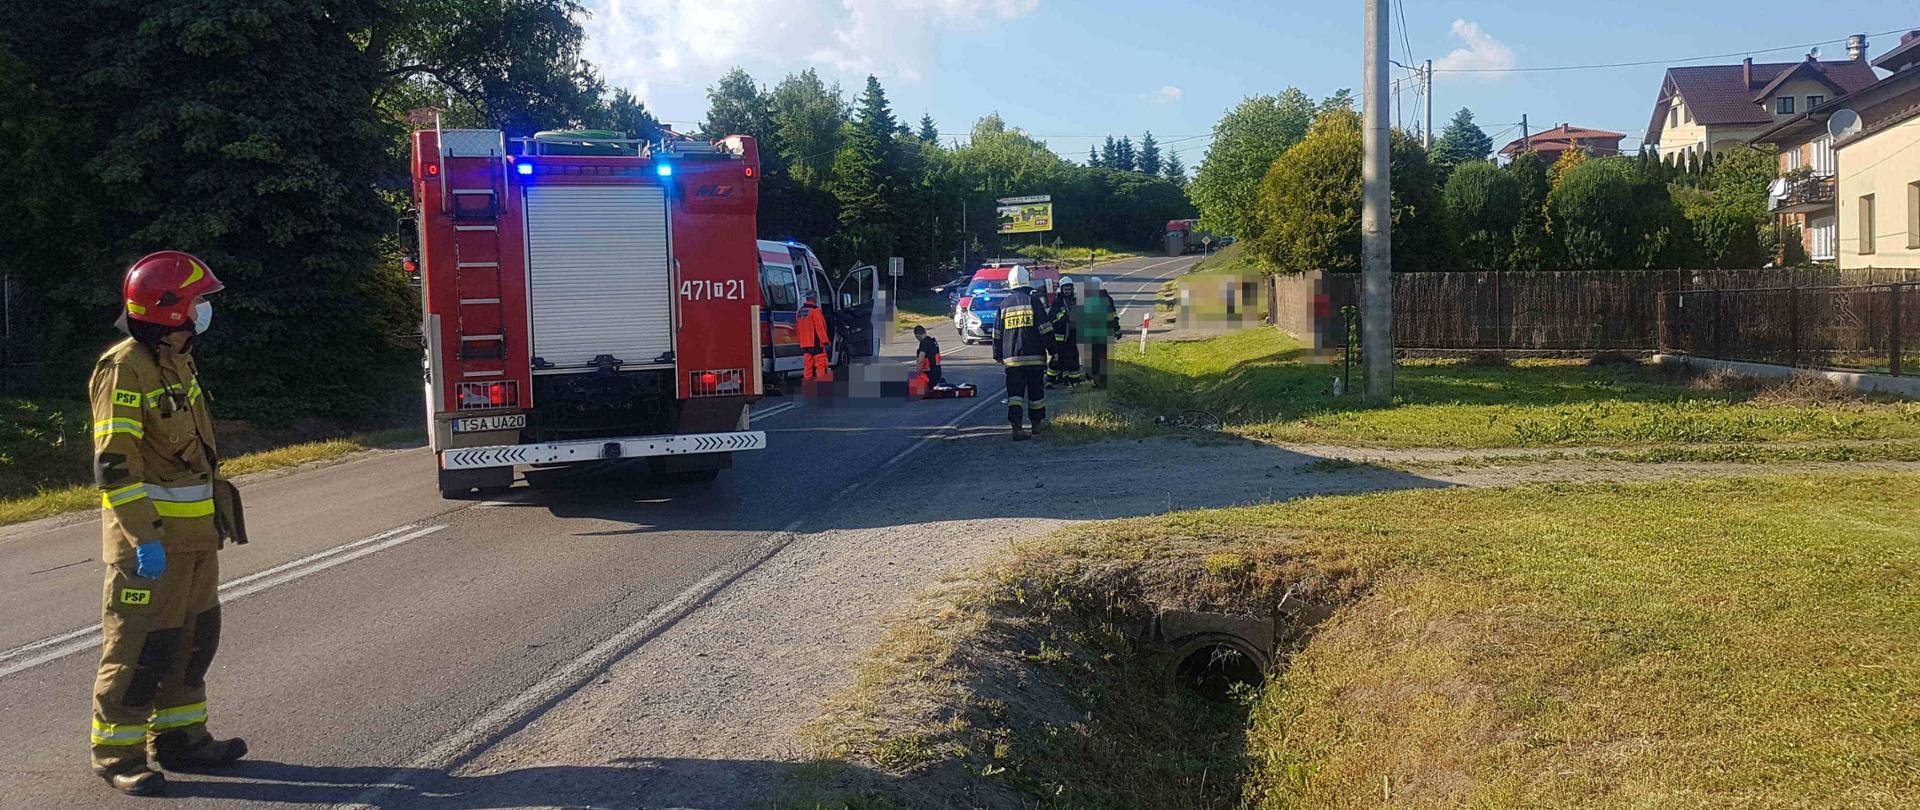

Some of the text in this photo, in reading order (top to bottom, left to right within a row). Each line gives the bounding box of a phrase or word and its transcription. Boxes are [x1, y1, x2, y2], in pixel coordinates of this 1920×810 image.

[680, 280, 711, 300] 471
[726, 280, 745, 299] 21
[116, 392, 136, 404] PSP
[461, 416, 524, 430] TSA UA20
[125, 592, 145, 602] PSP
